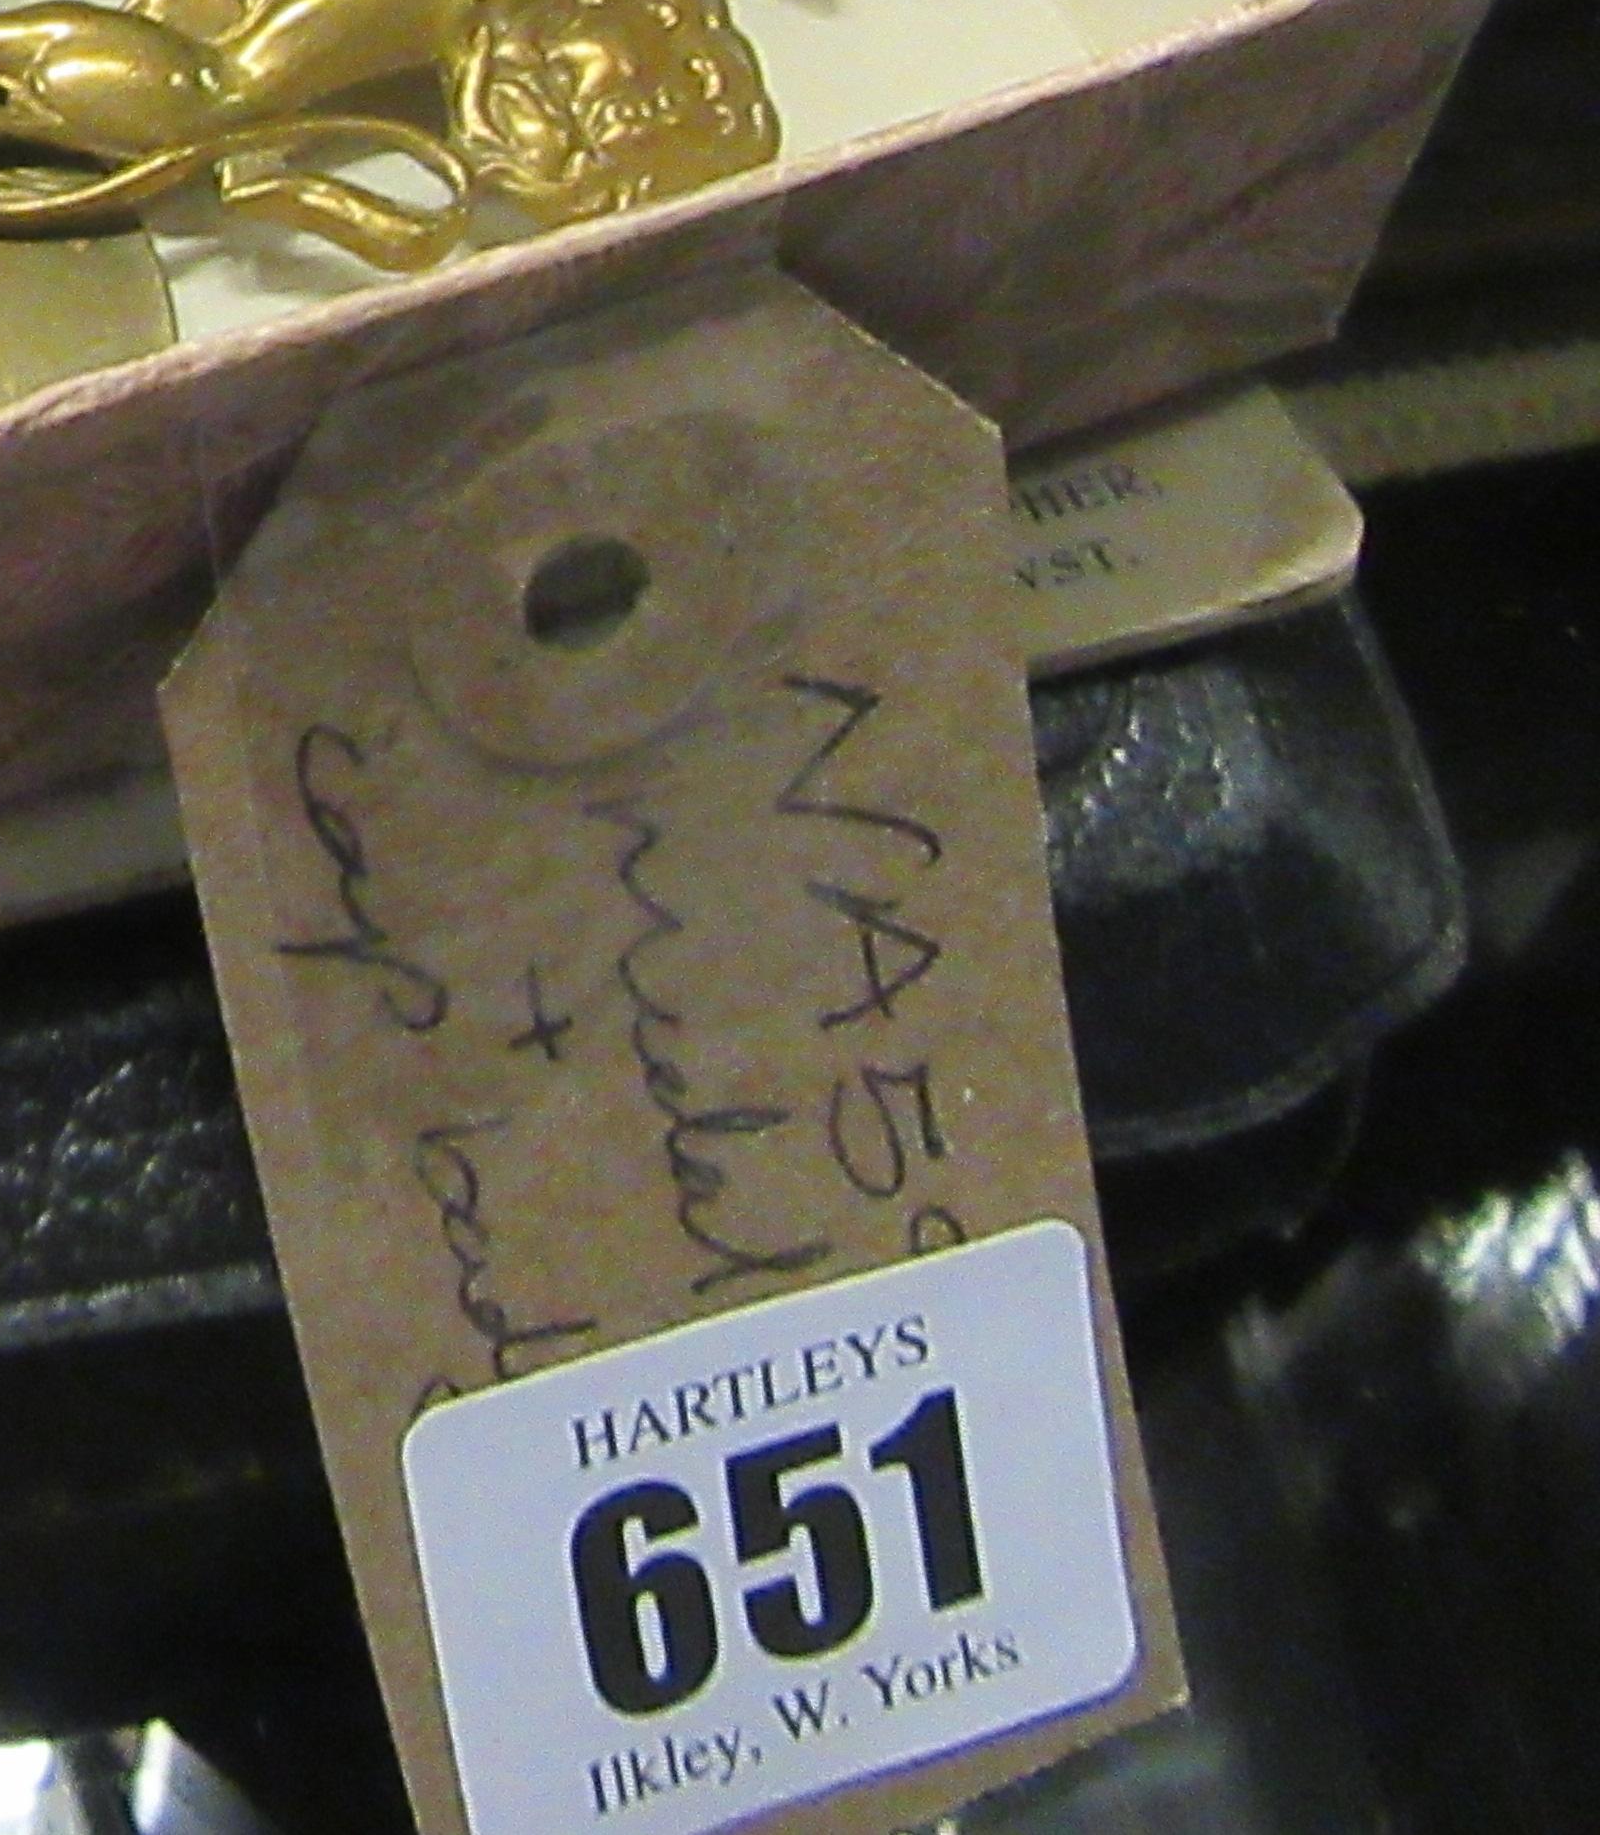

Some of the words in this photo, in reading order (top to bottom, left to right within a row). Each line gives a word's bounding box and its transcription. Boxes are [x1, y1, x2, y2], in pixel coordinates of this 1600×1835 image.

[411, 1116, 597, 1416] bad
[569, 1314, 930, 1469] HARTLEYS
[569, 1387, 986, 1718] 651
[587, 1725, 764, 1814] Ilkley,
[774, 1679, 849, 1743] W.
[863, 1631, 1021, 1711] Yorks
